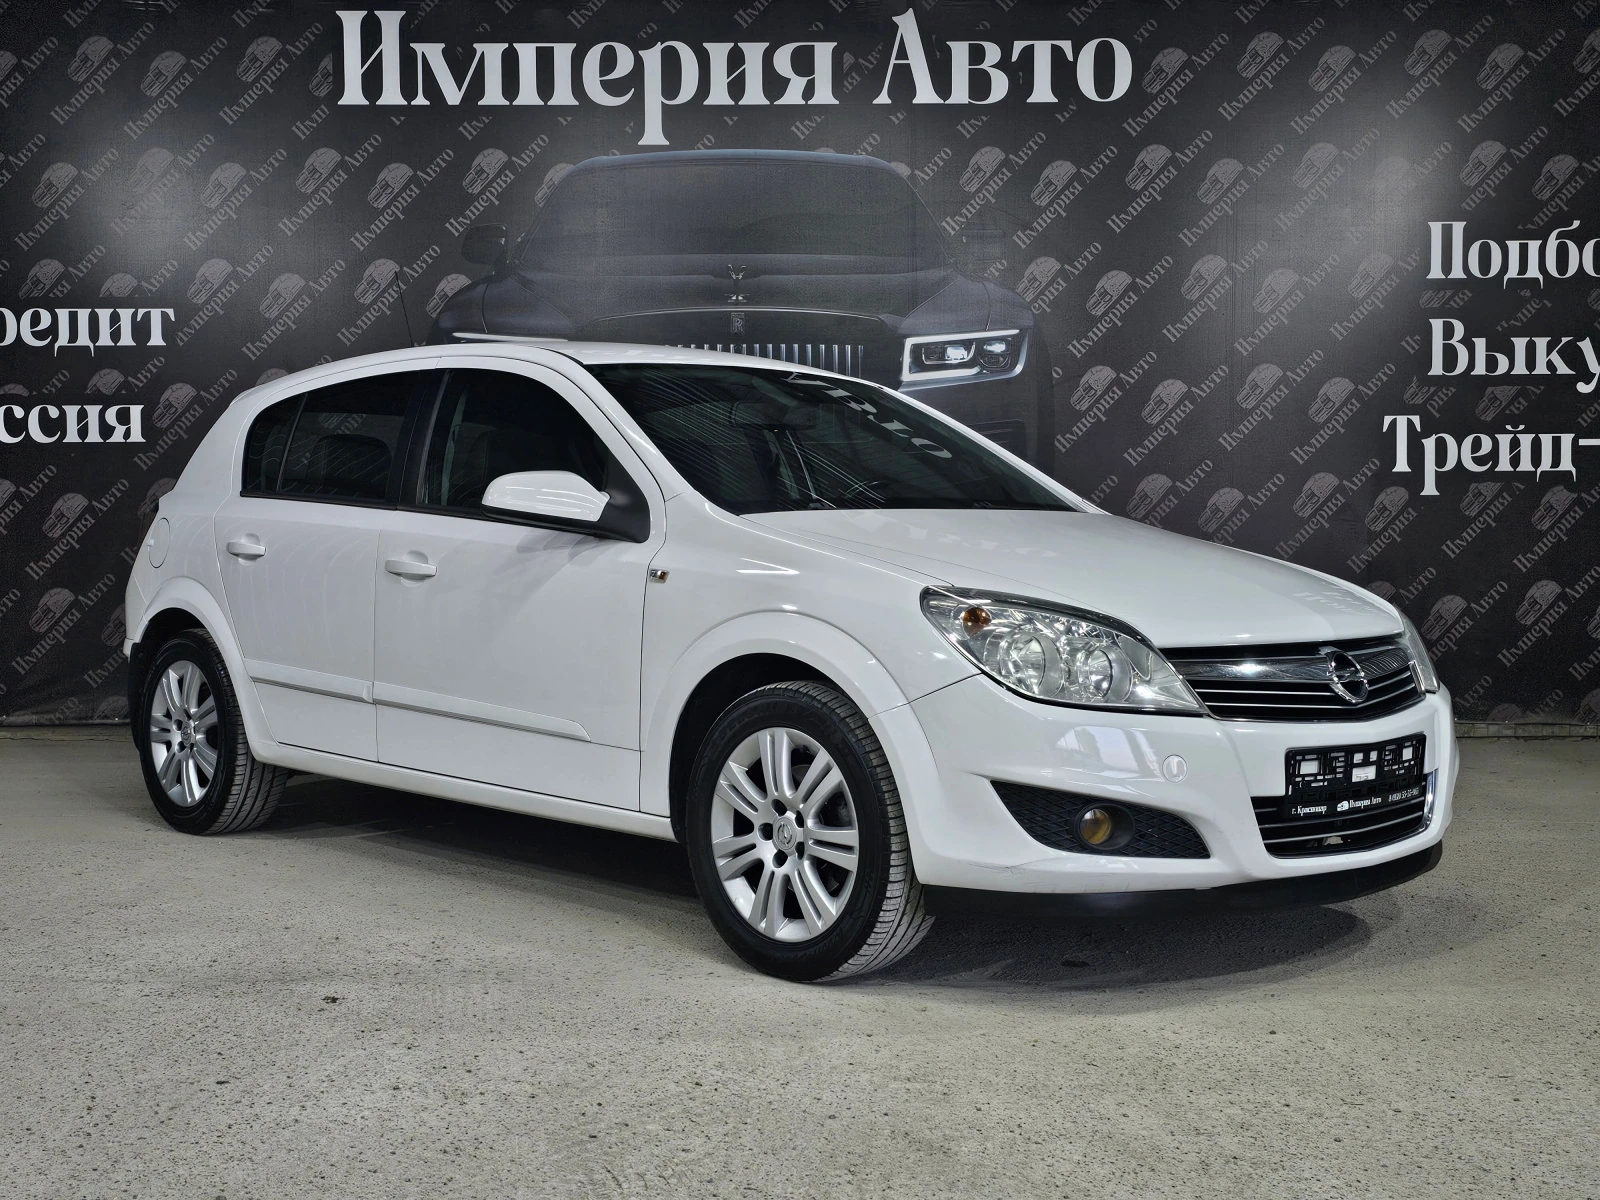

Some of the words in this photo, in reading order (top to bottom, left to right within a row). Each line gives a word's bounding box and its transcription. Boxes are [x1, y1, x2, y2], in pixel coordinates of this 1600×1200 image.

[23, 38, 61, 75] Авто
[50, 58, 120, 125] Империя
[117, 23, 155, 59] Авто
[122, 73, 192, 140] Империя
[189, 37, 228, 74] Авто
[216, 58, 287, 125] Империя
[284, 22, 322, 58] Авто
[336, 10, 840, 146] Империя
[873, 8, 1133, 105] Авто
[1123, 69, 1194, 135] Империя
[1190, 31, 1230, 68] Авто
[1218, 53, 1289, 120] Империя
[1285, 16, 1326, 53] Авто
[1290, 68, 1361, 134] Империя
[1357, 30, 1398, 67] Авто
[1385, 53, 1456, 119] Империя
[1452, 15, 1493, 52] Авто
[1457, 67, 1528, 133] Империя
[1525, 29, 1565, 66] Авто
[10, 135, 47, 172] Авто
[176, 134, 214, 171] Авто
[275, 169, 345, 235] Империя
[342, 133, 380, 170] Авто
[441, 168, 512, 234] Империя
[508, 132, 547, 169] Авто
[913, 144, 953, 181] Авто
[940, 166, 1011, 232] Империя
[1008, 129, 1047, 166] Авто
[1012, 180, 1083, 246] Империя
[1080, 143, 1120, 180] Авто
[1107, 165, 1178, 231] Империя
[1175, 128, 1214, 165] Авто
[1179, 180, 1250, 246] Империя
[1247, 143, 1287, 179] Авто
[1508, 126, 1549, 163] Авто
[14, 185, 85, 251] Империя
[82, 149, 120, 186] Авто
[180, 184, 251, 250] Империя
[248, 148, 286, 185] Авто
[347, 183, 417, 250] Империя
[414, 147, 453, 184] Авто
[68, 245, 106, 282] Авто
[140, 259, 178, 297] Авто
[234, 244, 272, 281] Авто
[333, 279, 403, 345] Империя
[400, 243, 438, 280] Авто
[1065, 239, 1104, 276] Авто
[1069, 291, 1139, 356] Империя
[1137, 254, 1176, 291] Авто
[1163, 275, 1234, 341] Империя
[1231, 239, 1271, 276] Авто
[1235, 290, 1306, 356] Империя
[1303, 253, 1342, 290] Авто
[1329, 275, 1400, 340] Империя
[239, 294, 309, 360] Империя
[306, 258, 344, 296] Авто
[127, 354, 165, 392] Авто
[131, 405, 202, 470] Империя
[199, 369, 237, 406] Авто
[1053, 386, 1124, 451] Империя
[1121, 349, 1160, 386] Авто
[1124, 400, 1195, 466] Империя
[1193, 364, 1232, 401] Авто
[1219, 385, 1290, 451] Империя
[1287, 349, 1326, 385] Авто
[1290, 400, 1361, 465] Империя
[1359, 363, 1398, 400] Авто
[20, 464, 58, 502] Авто
[25, 515, 95, 579] Империя
[92, 478, 129, 517] Авто
[1177, 459, 1216, 496] Авто
[1249, 473, 1288, 510] Авто
[1274, 494, 1345, 559] Империя
[1343, 458, 1382, 495] Авто
[1440, 493, 1511, 559] Империя
[1346, 509, 1416, 574] Империя
[1398, 567, 1437, 603] Авто
[1511, 508, 1582, 573] Империя
[12, 609, 82, 673] Империя
[79, 573, 116, 611] Авто
[1470, 581, 1508, 618] Авто
[1494, 602, 1565, 667] Империя
